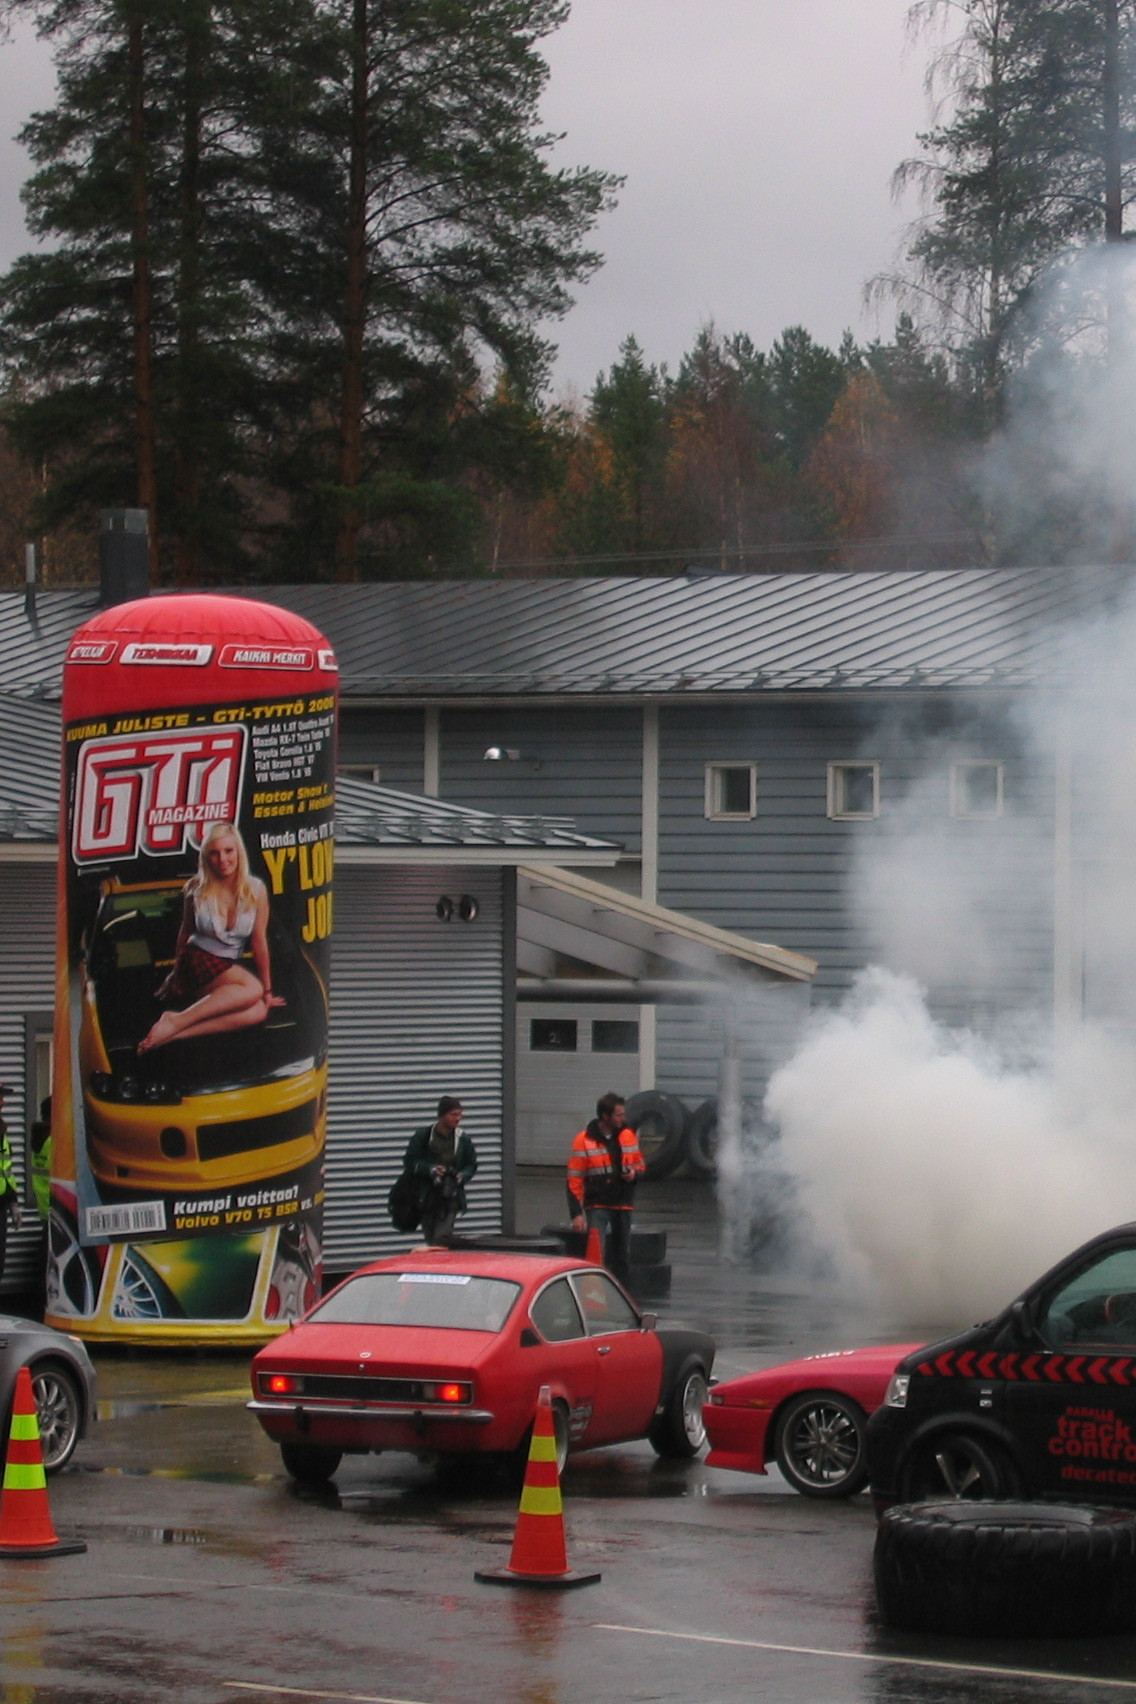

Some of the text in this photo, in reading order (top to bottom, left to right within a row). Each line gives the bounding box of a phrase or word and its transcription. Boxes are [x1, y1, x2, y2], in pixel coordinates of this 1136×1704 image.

[272, 652, 307, 665] MERKIT
[112, 713, 190, 734] JULISTE
[252, 736, 278, 748] Mazda
[253, 748, 279, 760] Toyota
[254, 761, 271, 771] Fiat
[78, 736, 238, 856] GTi
[253, 790, 294, 804] Motor
[149, 803, 230, 825] MAGAZINE
[254, 803, 294, 818] Essen
[260, 831, 296, 849] Honda
[298, 826, 318, 845] Civic
[173, 1195, 230, 1215] Kumpi
[237, 1185, 299, 1208] voittaa?
[174, 1214, 219, 1229] Volvo
[225, 1210, 252, 1225] V70
[1056, 1415, 1132, 1443] track
